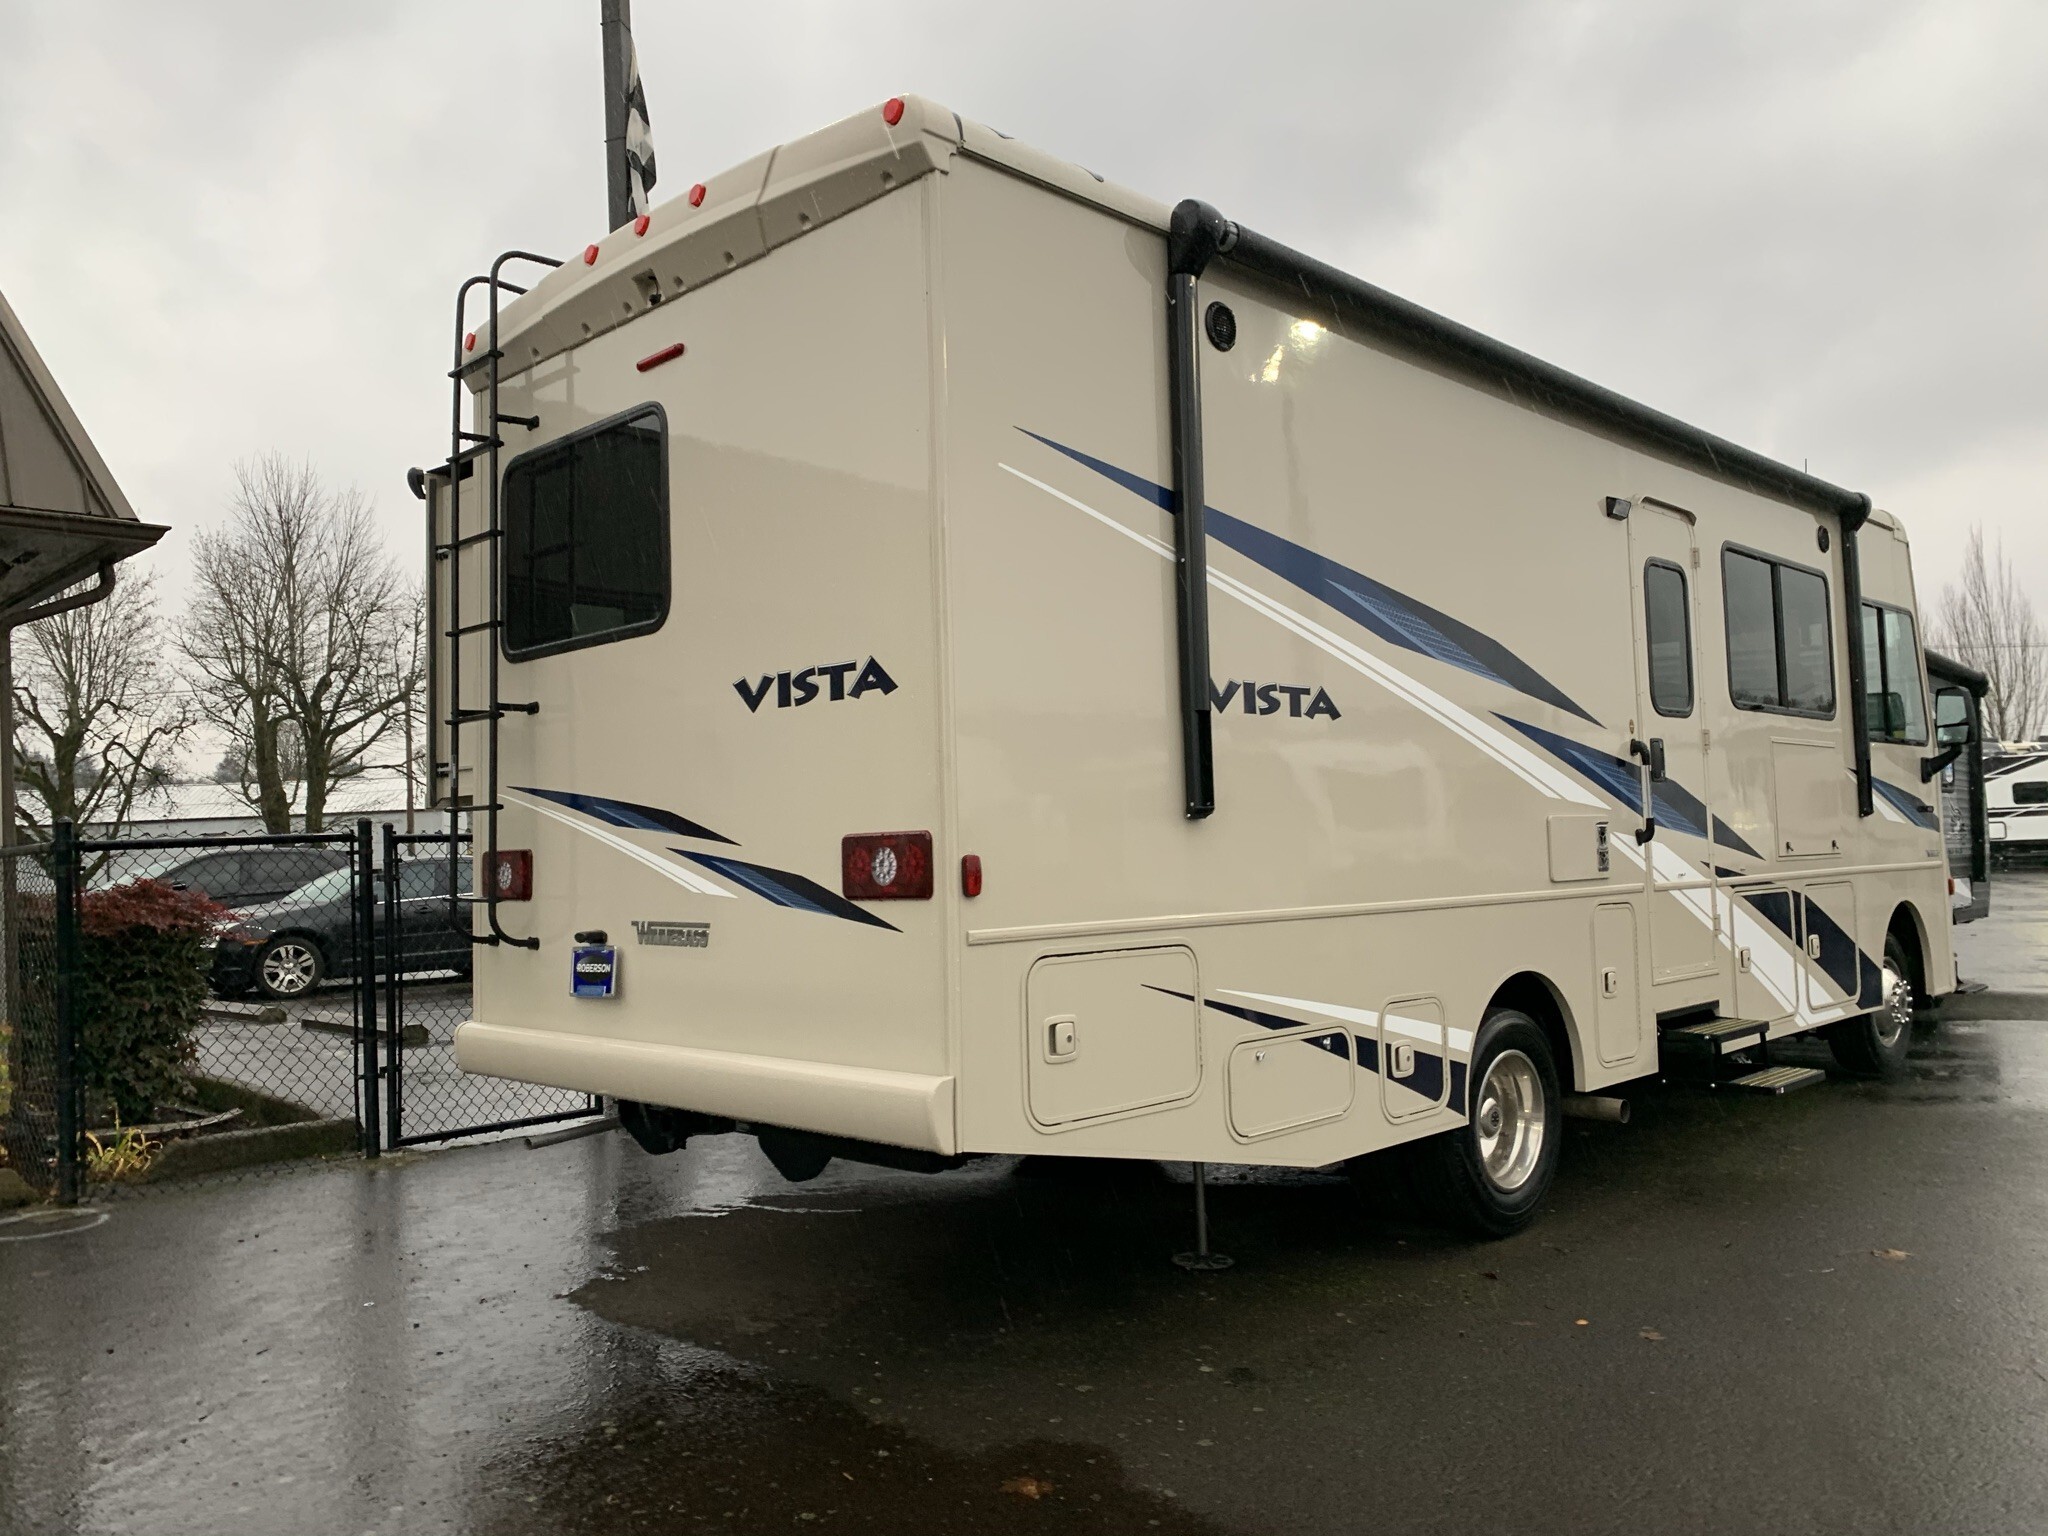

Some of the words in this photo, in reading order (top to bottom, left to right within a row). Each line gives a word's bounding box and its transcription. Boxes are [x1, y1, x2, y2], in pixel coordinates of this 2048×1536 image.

[733, 655, 898, 713] VISTA
[1210, 678, 1342, 721] VISTA
[576, 963, 611, 973] ROBERSON
